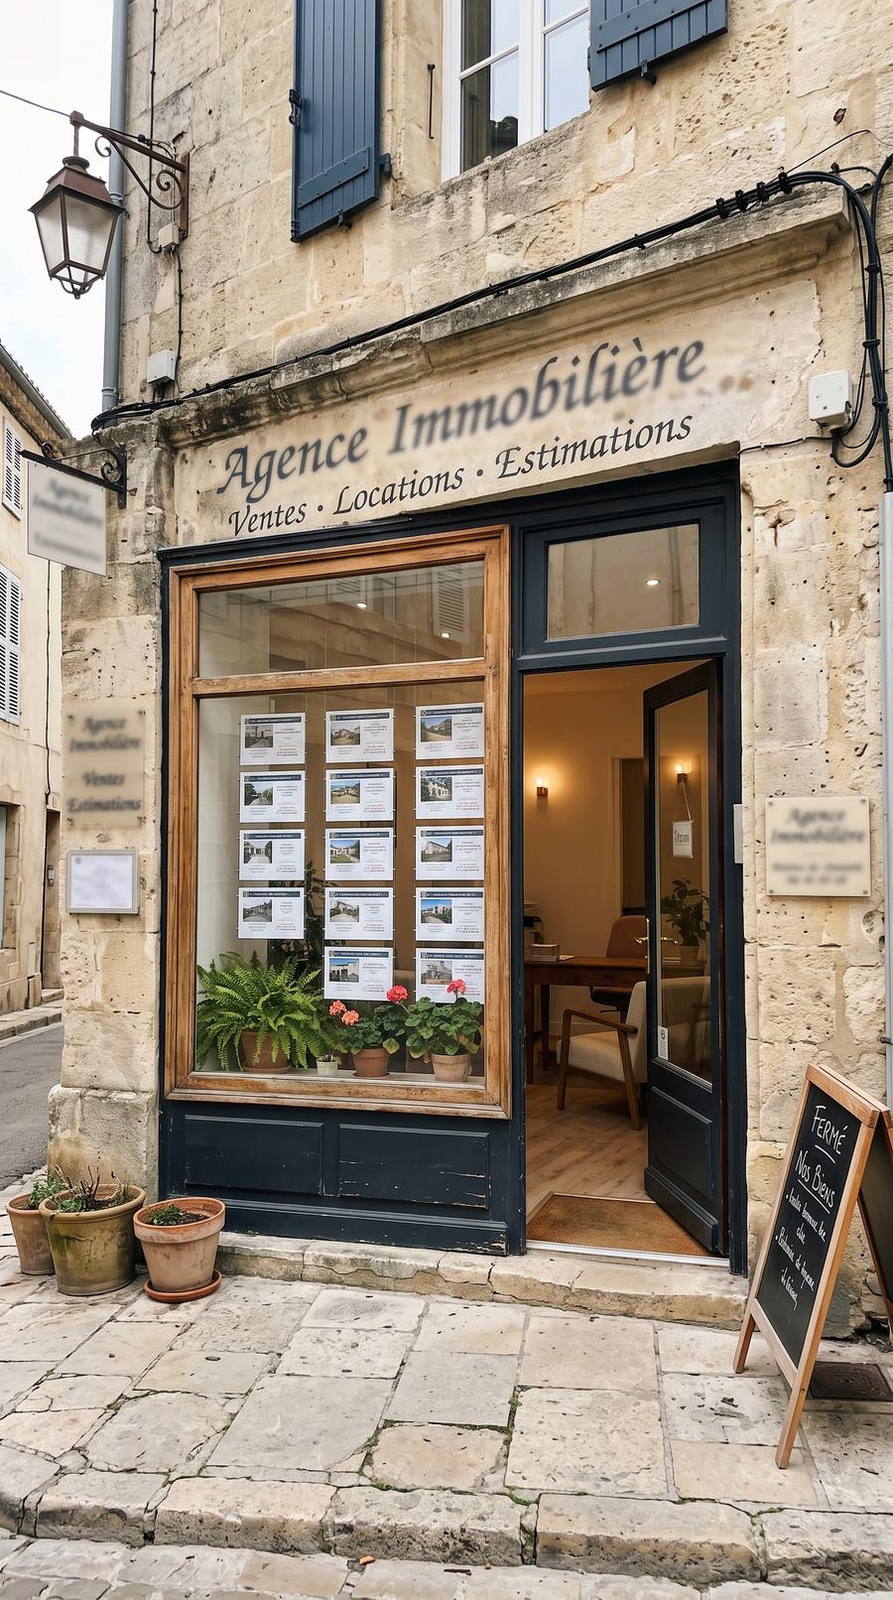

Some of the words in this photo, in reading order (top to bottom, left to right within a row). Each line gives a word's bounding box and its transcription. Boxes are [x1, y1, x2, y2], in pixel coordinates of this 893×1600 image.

[216, 427, 368, 504] Agence
[388, 337, 706, 454] Immobilière
[228, 503, 307, 537] Ventes
[332, 467, 464, 515] Locations
[495, 414, 694, 480] Estimations
[811, 1105, 848, 1155] FERMÉ
